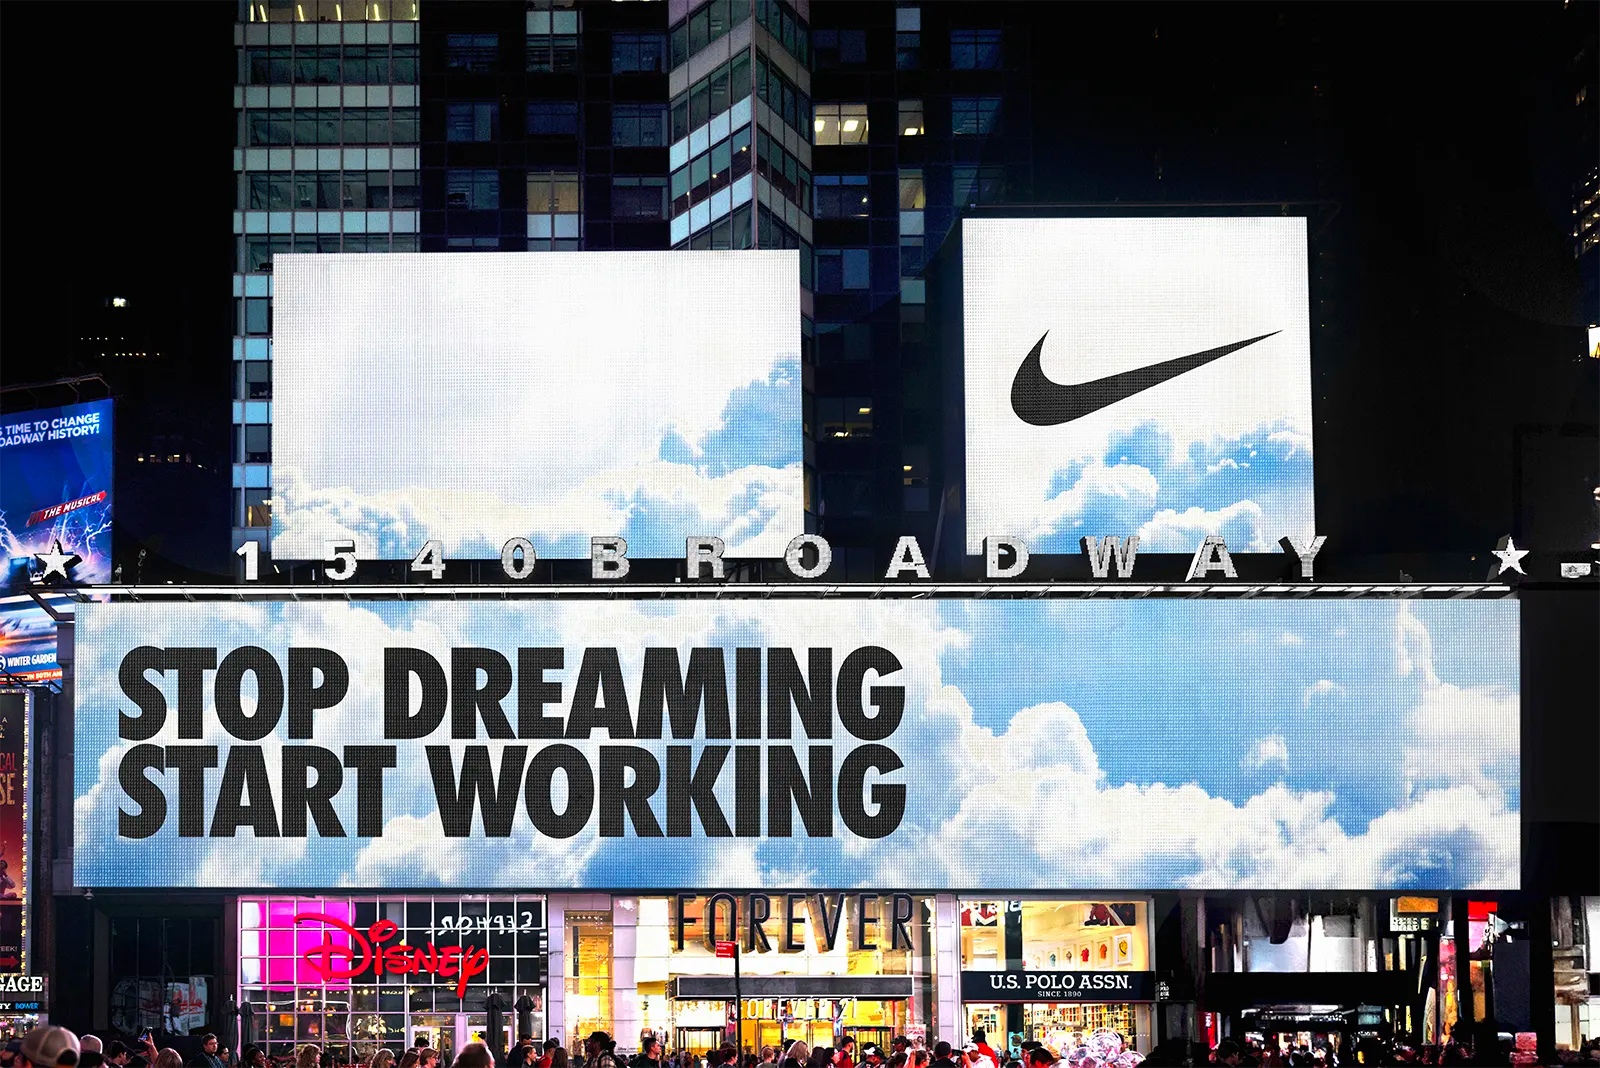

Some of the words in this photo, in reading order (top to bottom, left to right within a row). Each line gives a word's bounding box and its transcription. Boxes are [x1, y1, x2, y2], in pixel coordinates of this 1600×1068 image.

[5, 422, 31, 436] TIME
[34, 420, 49, 432] TO
[51, 412, 100, 429] CHANGE
[48, 423, 100, 441] HISTORY!
[43, 506, 62, 520] THE
[63, 493, 102, 513] MUSICAL
[7, 655, 31, 668] WINTER
[31, 652, 57, 666] GARDEN
[119, 645, 350, 741] STOP
[384, 645, 906, 741] DREAMING
[119, 744, 397, 839] START
[427, 744, 907, 839] WORKING
[676, 892, 915, 953] FOREVER
[989, 974, 1021, 990] U.S.
[1025, 974, 1075, 990] POLO
[1078, 974, 1133, 990] ASSN.
[1037, 990, 1061, 998] SINCE
[1064, 990, 1082, 998] 1890
[837, 997, 857, 1019] 21
